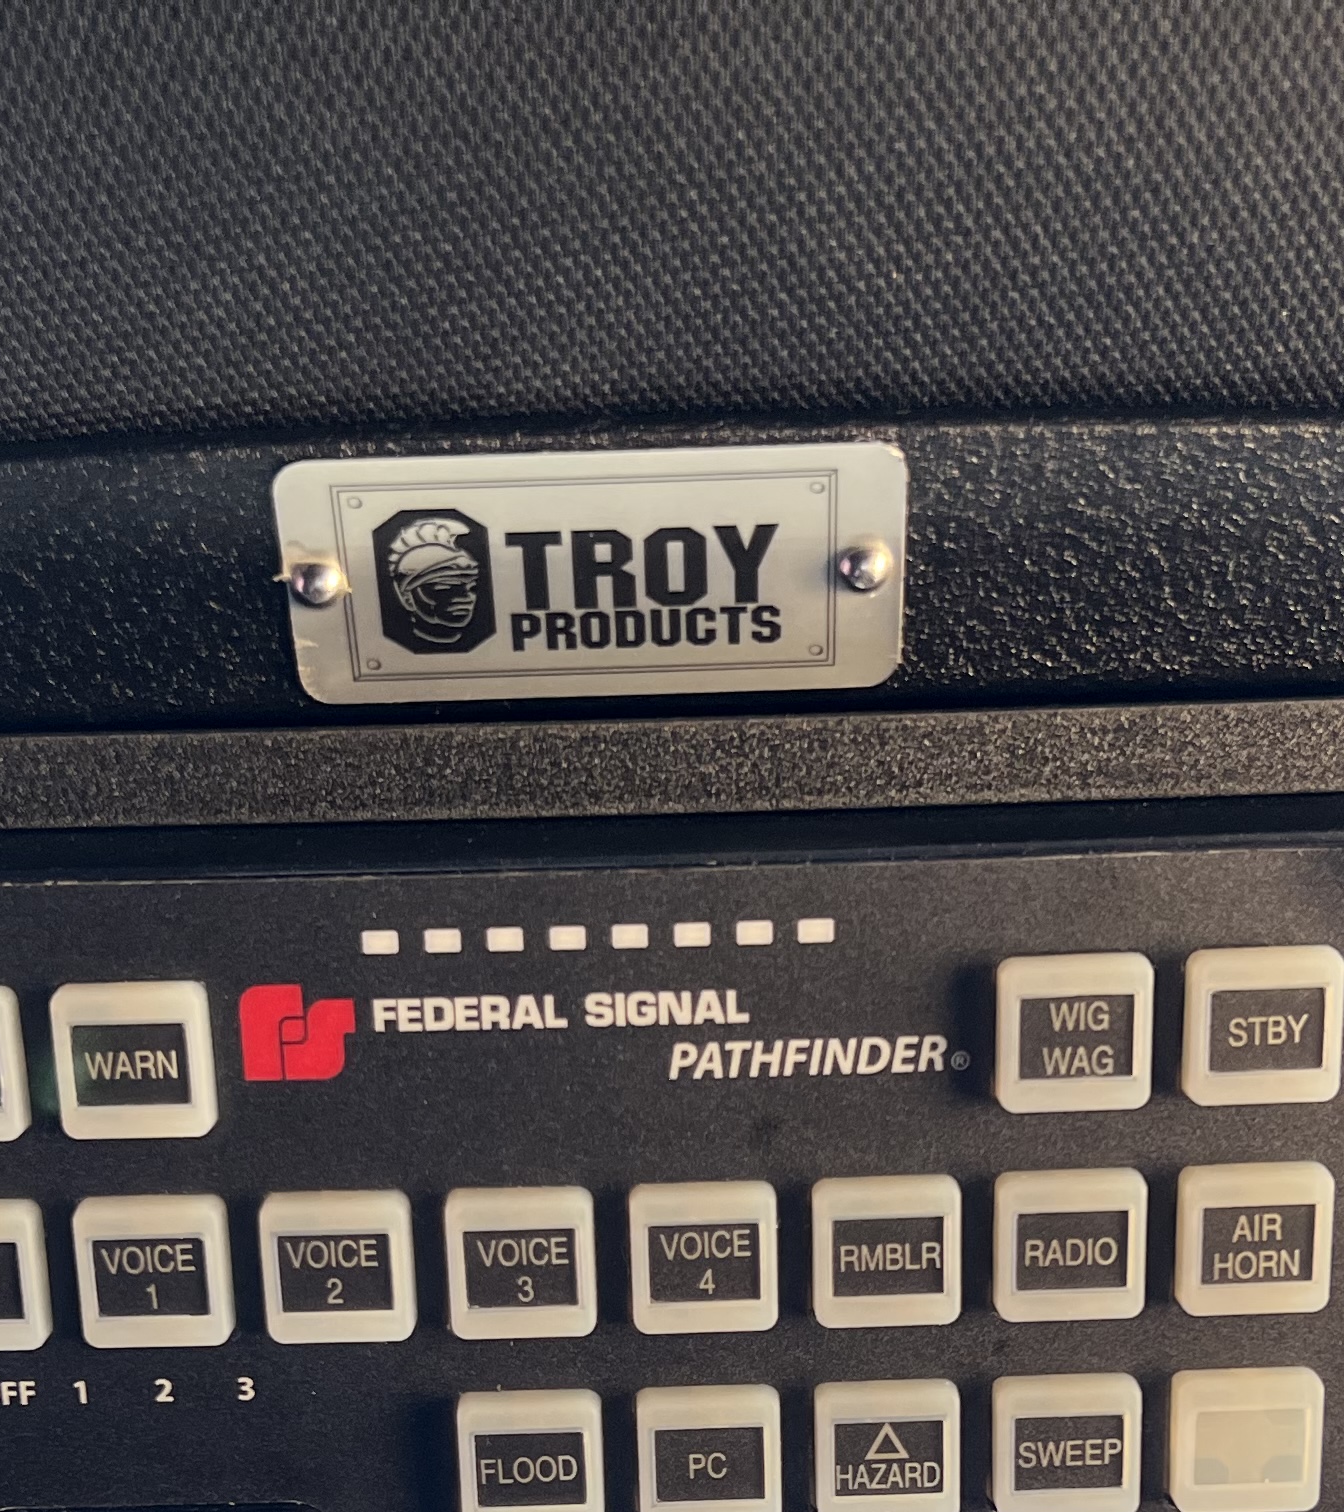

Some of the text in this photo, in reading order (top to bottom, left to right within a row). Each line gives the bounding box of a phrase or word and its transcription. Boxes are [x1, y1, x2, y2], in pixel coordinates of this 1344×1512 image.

[505, 524, 780, 611] TROY
[511, 605, 782, 651] PRODUCTS
[372, 989, 750, 1032] FEDERAL SIGNAL
[1049, 1001, 1110, 1032] WIG
[1228, 1013, 1309, 1047] STBY
[84, 1049, 179, 1080] WARN
[1042, 1045, 1114, 1076] WAG
[1231, 1212, 1283, 1243] AIR
[100, 1243, 196, 1275] VOICE
[284, 1238, 379, 1269] VOICE
[476, 1236, 570, 1267] VOICE
[659, 1228, 752, 1261] VOICE
[839, 1241, 941, 1273] RMBLR
[1024, 1236, 1118, 1267] RADIO
[1213, 1249, 1301, 1280] HORN
[145, 1283, 159, 1310] 1
[326, 1277, 344, 1305] 2
[516, 1275, 535, 1303] 3
[698, 1267, 716, 1295] 4
[73, 1380, 88, 1404] 1
[154, 1378, 175, 1403] 2
[237, 1376, 256, 1401] 3
[688, 1452, 728, 1480] PC
[1018, 1438, 1122, 1469] SWEEP
[479, 1454, 578, 1485] FLOOD
[835, 1461, 941, 1490] HAZARD
